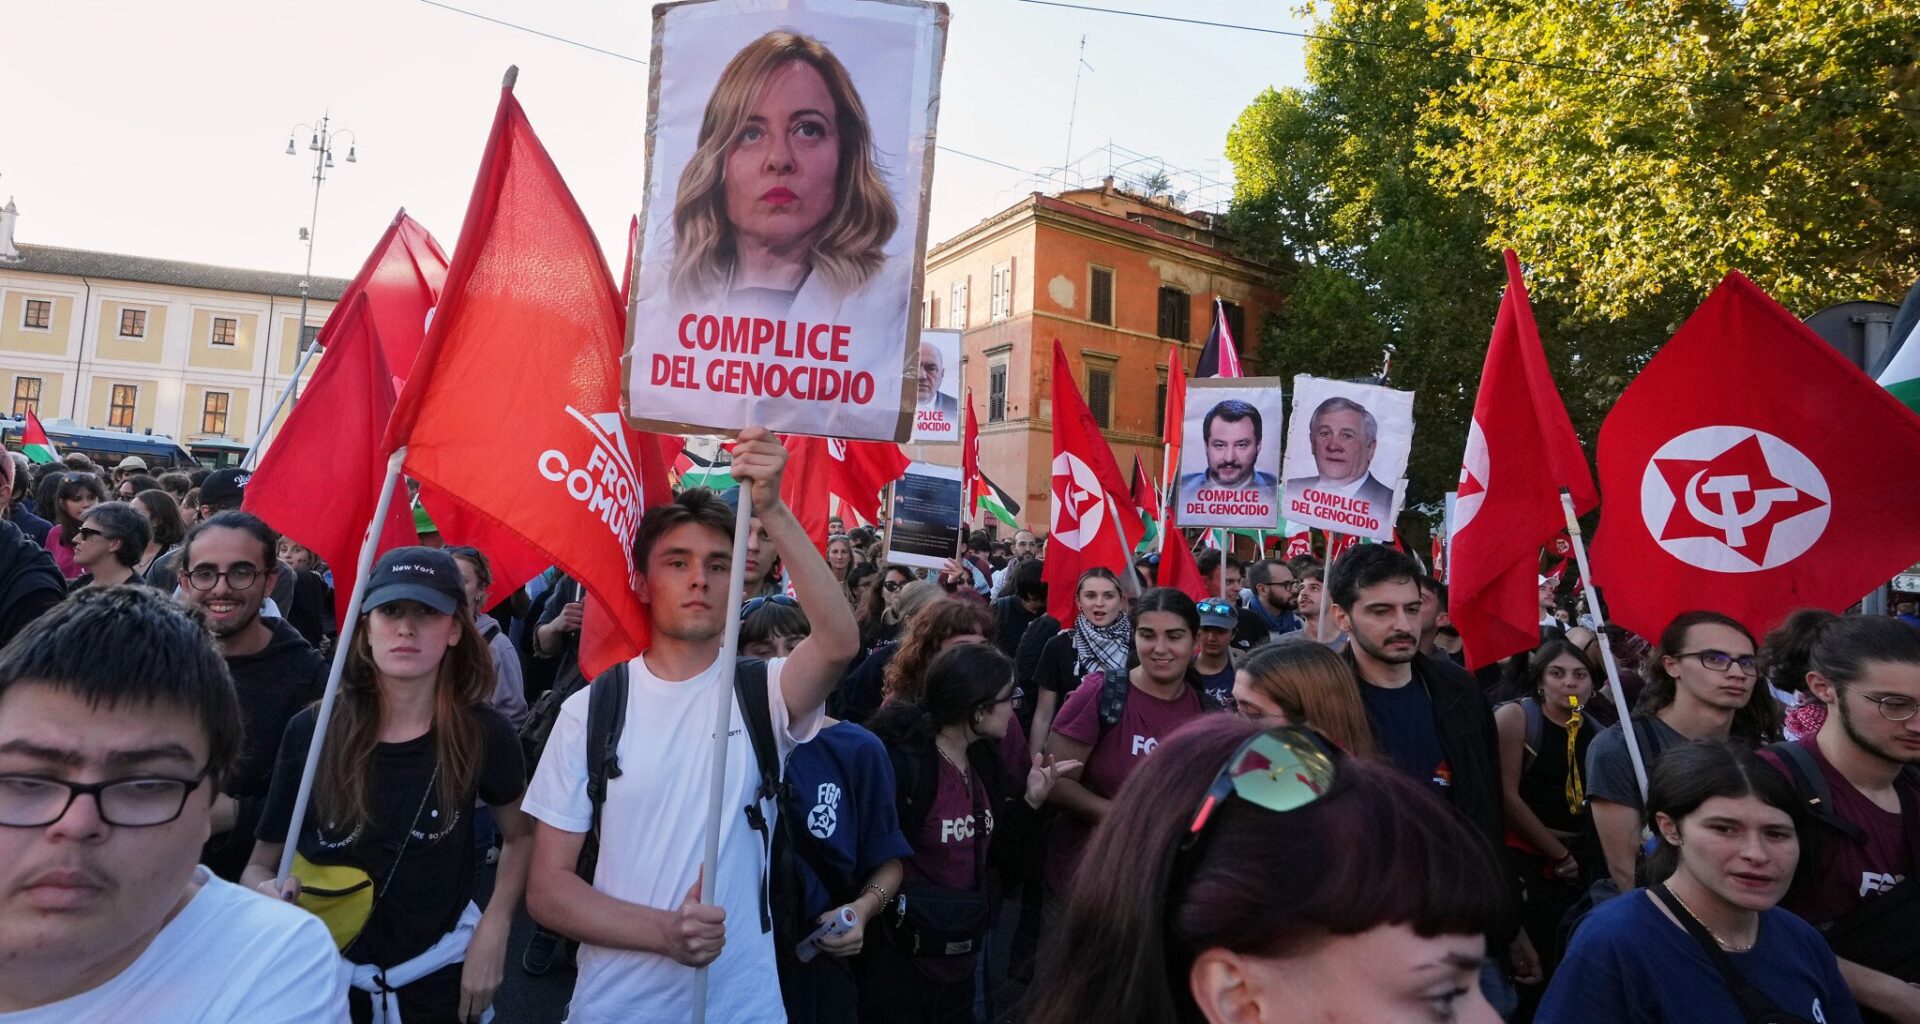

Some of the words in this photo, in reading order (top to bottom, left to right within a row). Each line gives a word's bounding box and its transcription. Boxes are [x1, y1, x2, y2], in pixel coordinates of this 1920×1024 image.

[678, 313, 851, 362] COMPLICE
[650, 353, 700, 390] DEL
[706, 358, 875, 405] GENOCIDIO
[917, 410, 944, 421] PLICE
[917, 421, 952, 432] NOCIDIO
[1186, 503, 1206, 514] DEL
[1208, 503, 1269, 516] GENOCIDIO
[1197, 489, 1260, 503] COMPLICE
[1302, 488, 1370, 515] COMPLICE
[1291, 500, 1312, 516] DEL
[1314, 506, 1379, 531] GENOCIDIO
[391, 564, 411, 573] New
[413, 564, 435, 575] York
[817, 782, 841, 810] FGC
[941, 814, 975, 843] FGC
